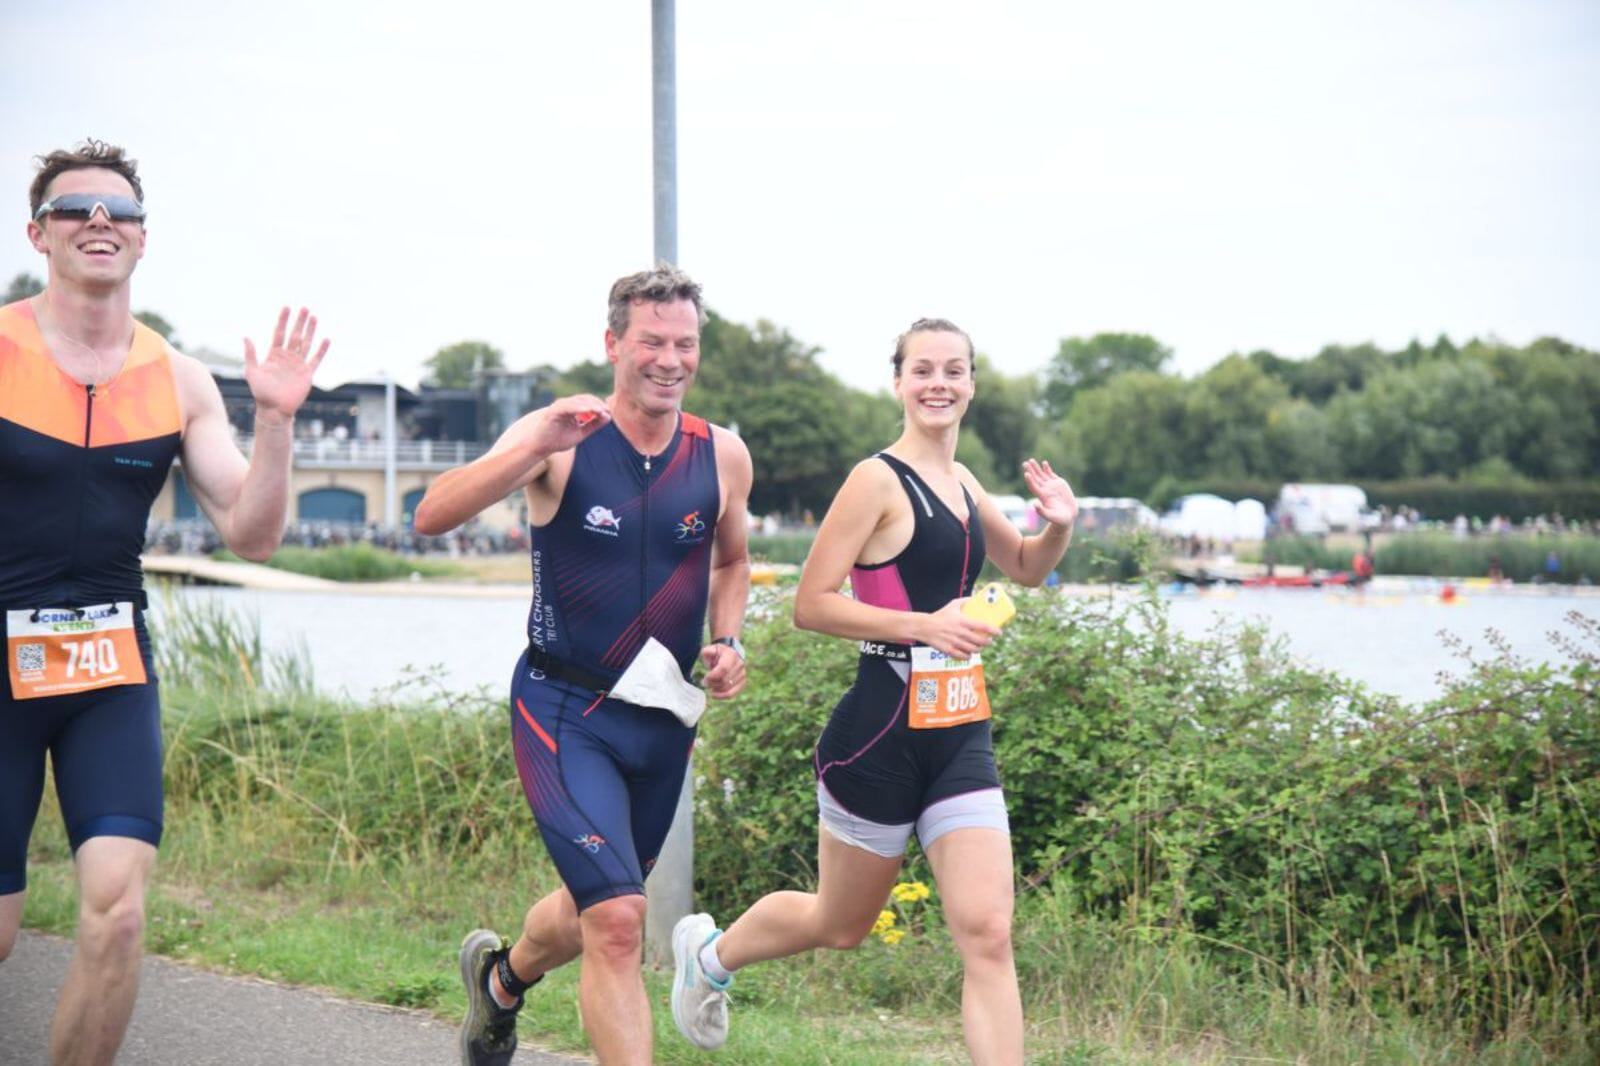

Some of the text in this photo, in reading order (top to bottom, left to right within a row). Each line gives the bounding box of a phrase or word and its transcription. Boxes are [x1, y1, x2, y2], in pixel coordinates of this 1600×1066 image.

[544, 604, 558, 641] TRI CLUB
[61, 638, 119, 678] 740
